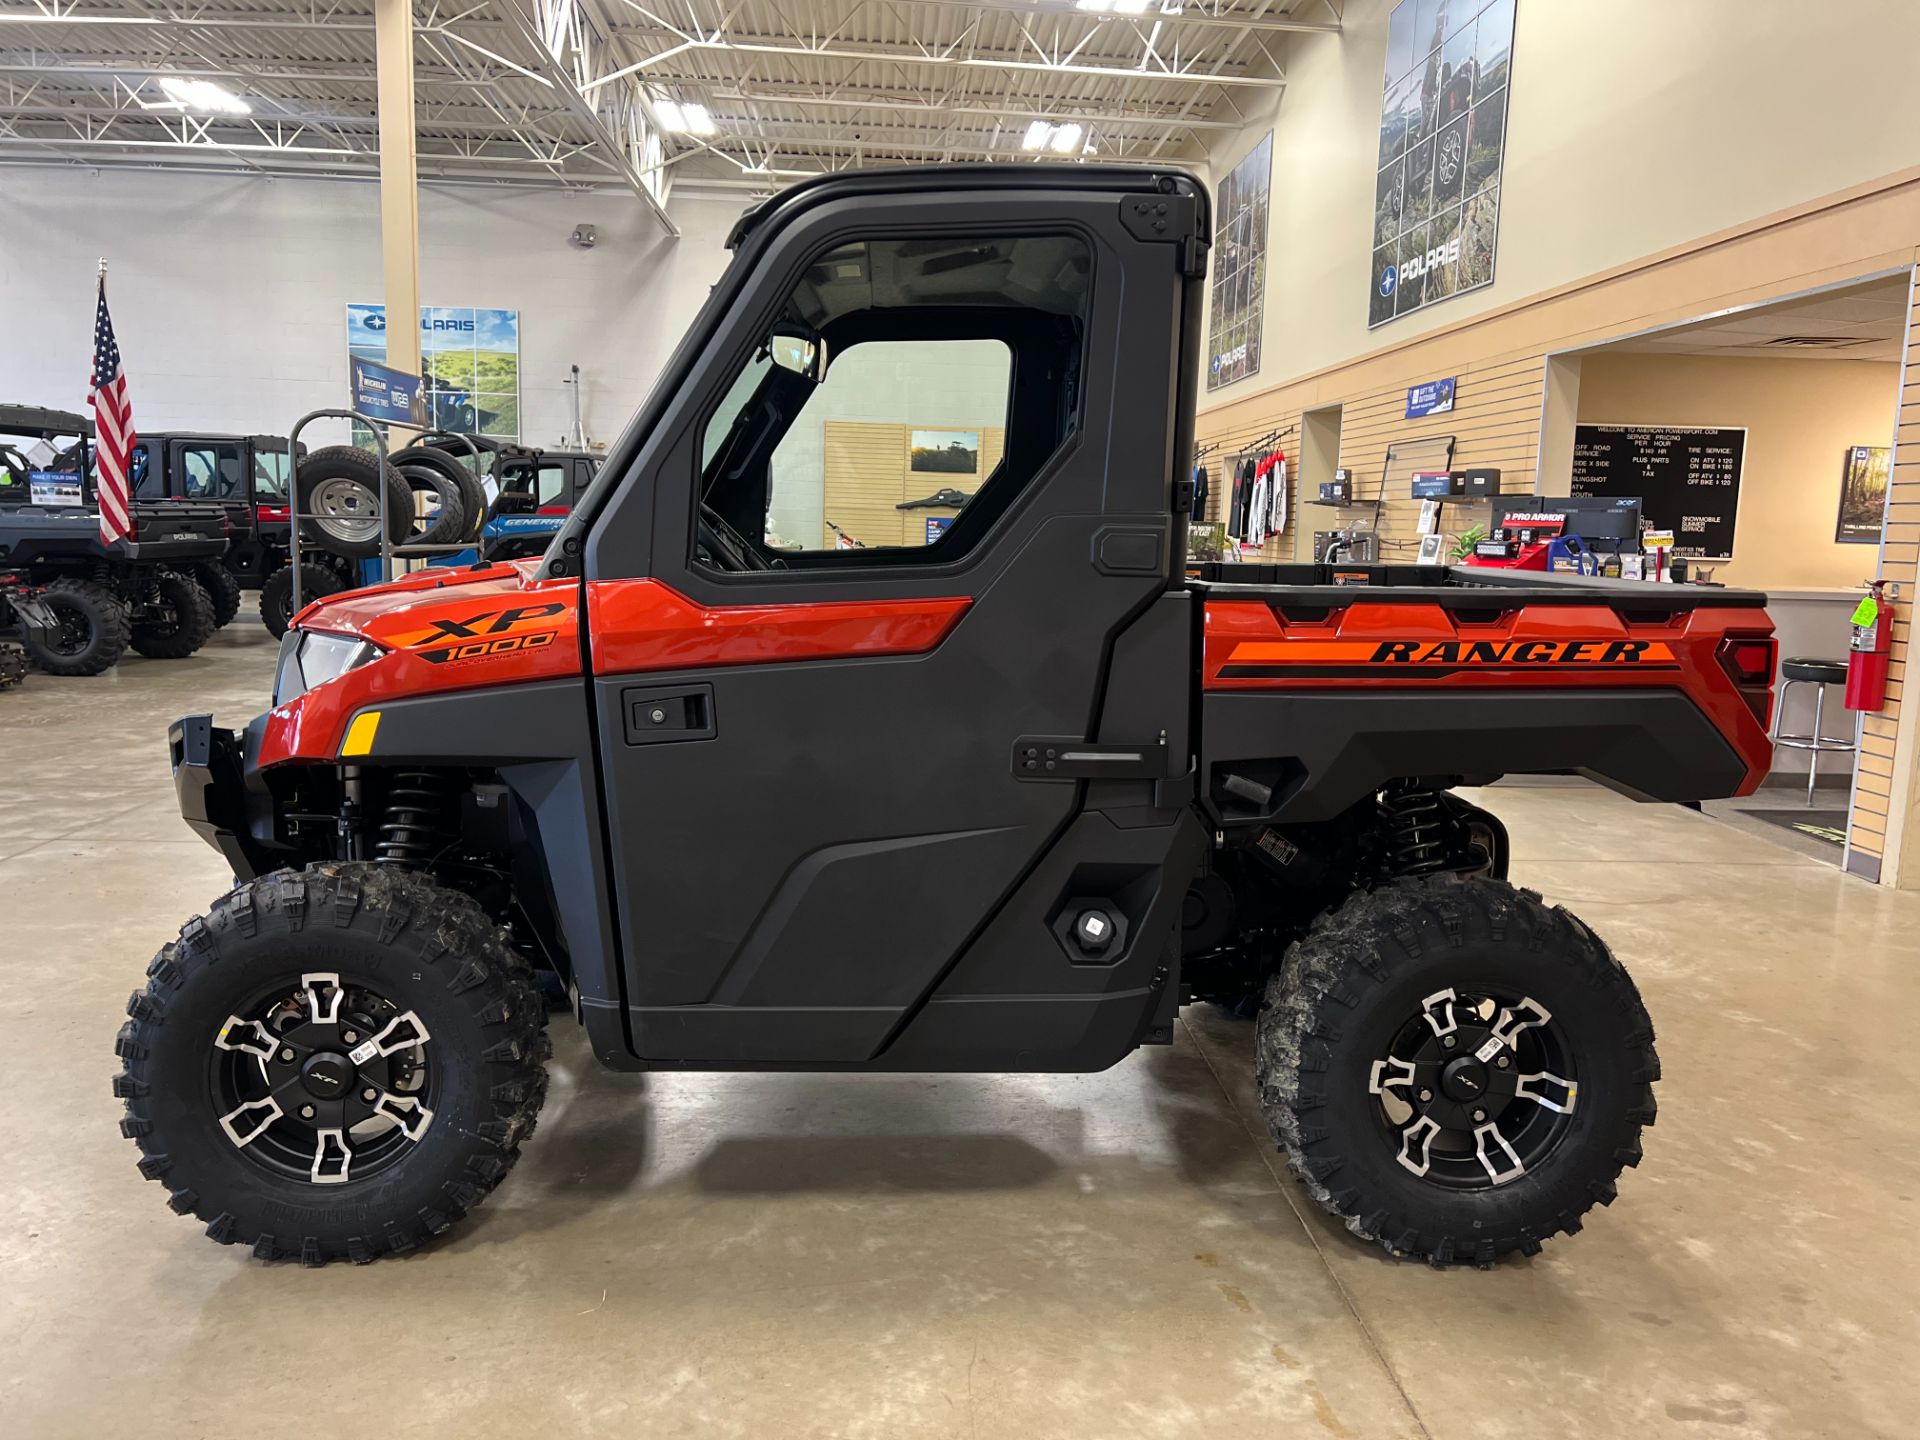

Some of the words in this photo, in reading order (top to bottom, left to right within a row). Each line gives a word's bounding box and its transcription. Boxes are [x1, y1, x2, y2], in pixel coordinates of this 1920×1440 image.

[1400, 239, 1460, 285] POLARIS
[421, 319, 475, 331] LARIS
[1221, 344, 1246, 368] POLARIS
[1572, 475, 1607, 483] SLINGSHOT
[1512, 512, 1531, 521] PRO
[1531, 512, 1566, 522] ARMOR
[173, 533, 198, 541] POLARIS
[409, 603, 566, 647] XP
[446, 632, 555, 661] 1000
[1368, 640, 1651, 663] RANGER
[310, 1072, 339, 1085] XP
